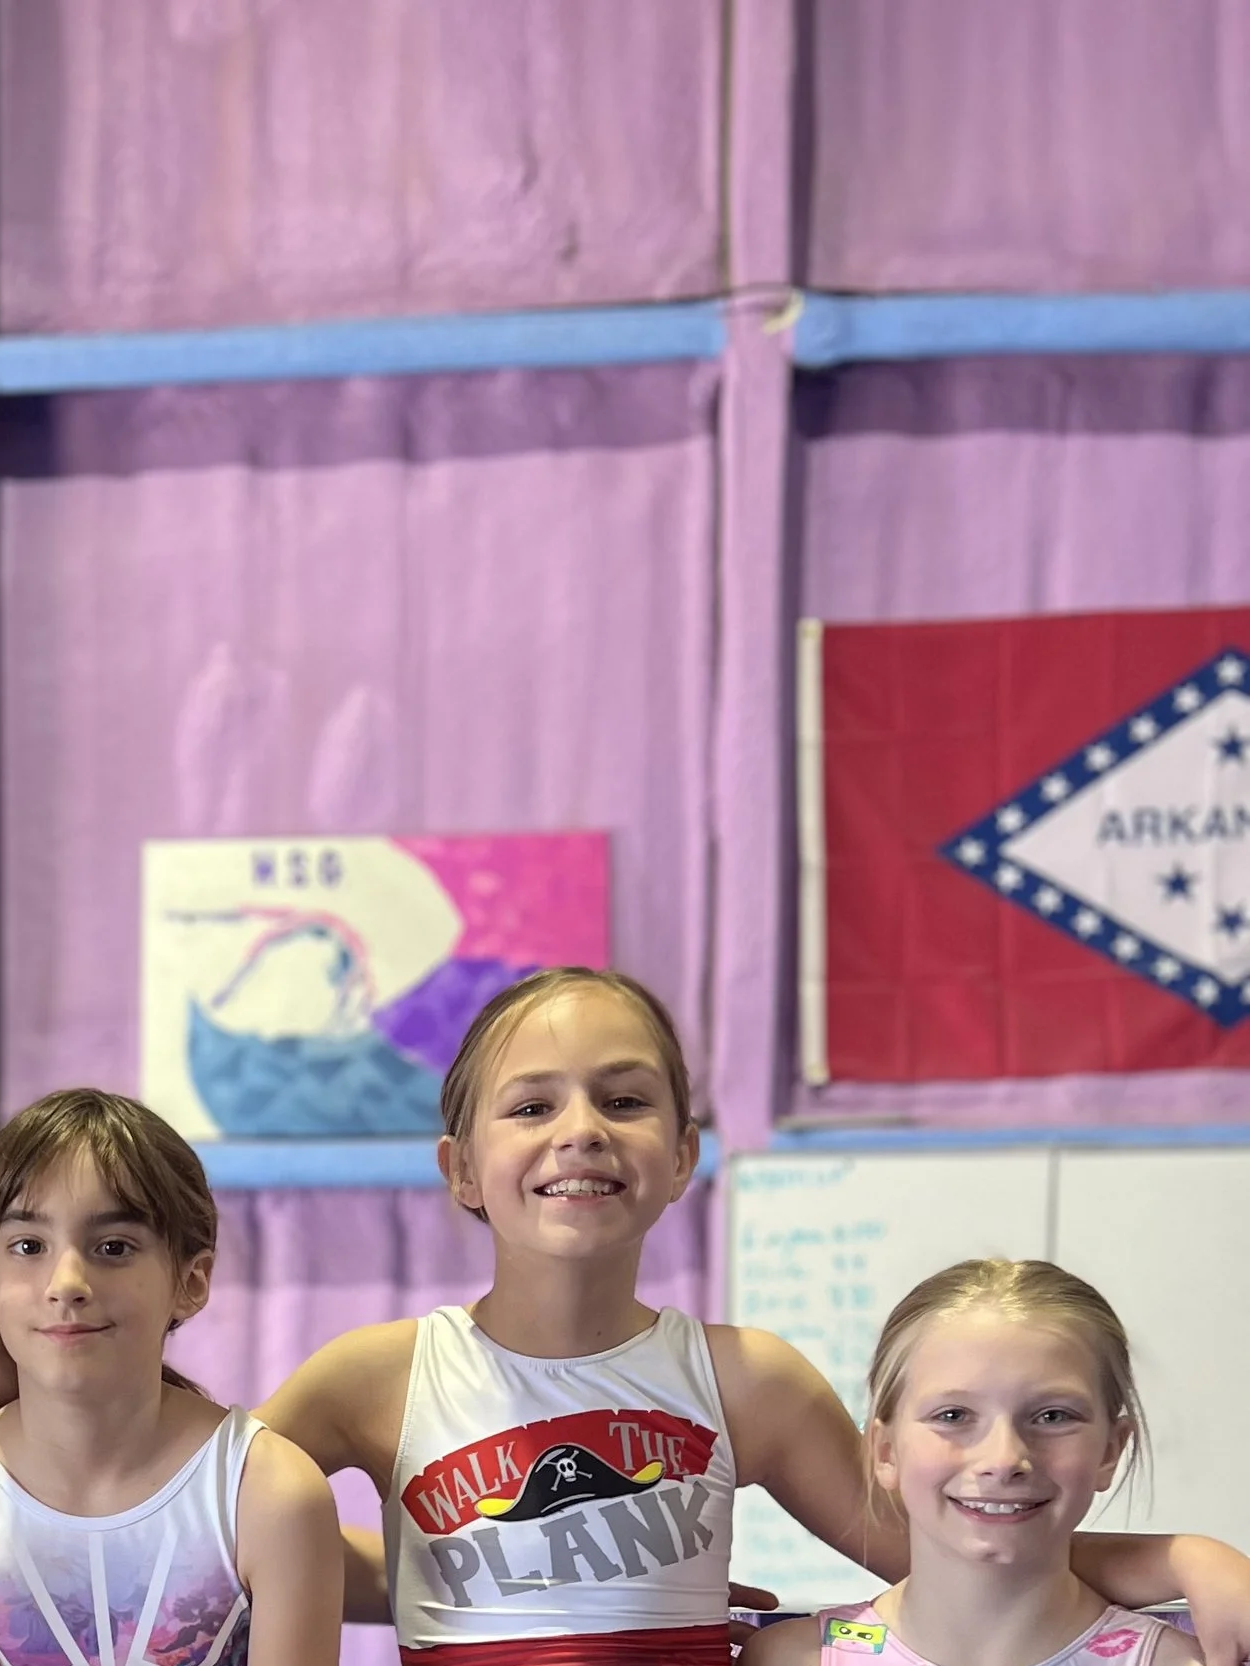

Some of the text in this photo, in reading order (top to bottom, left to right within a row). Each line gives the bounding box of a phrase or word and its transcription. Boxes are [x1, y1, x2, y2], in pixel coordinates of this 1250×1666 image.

[418, 1421, 690, 1530] WALK THE
[428, 1481, 713, 1608] PLANK
